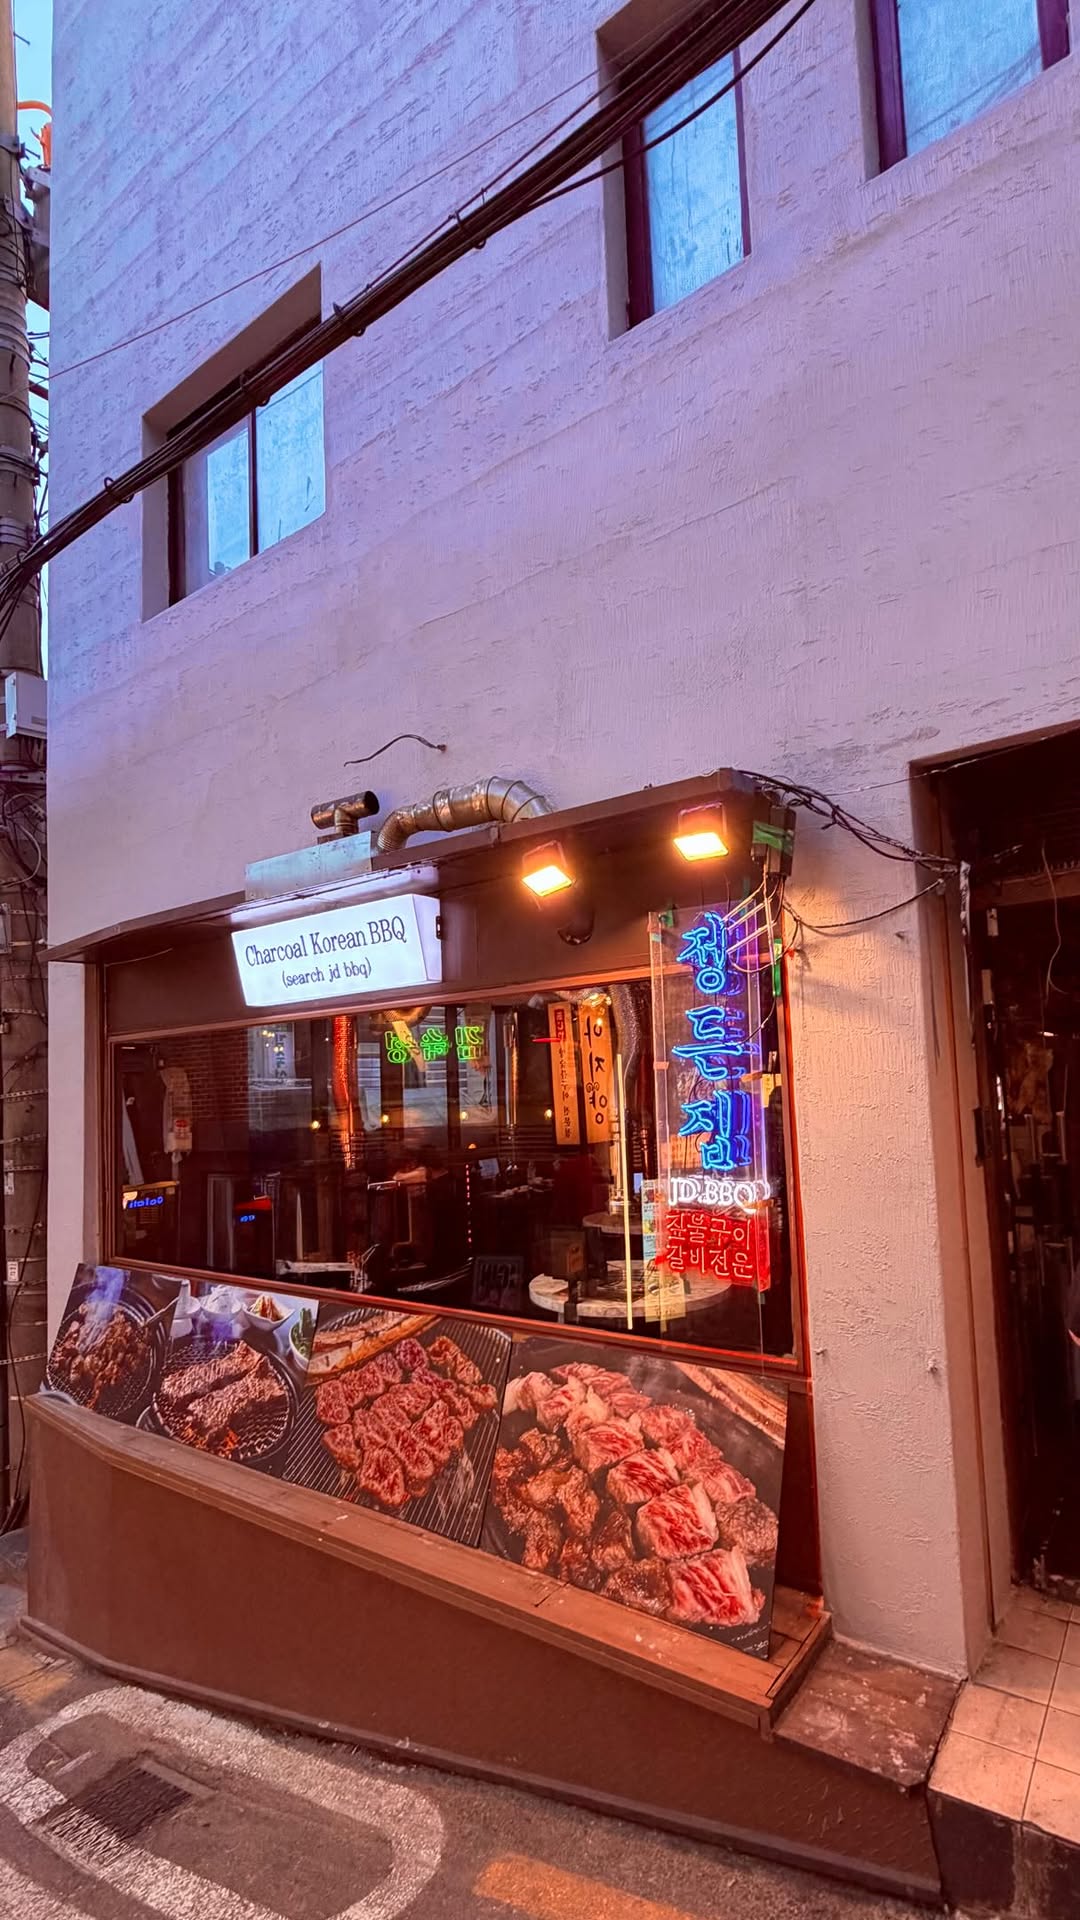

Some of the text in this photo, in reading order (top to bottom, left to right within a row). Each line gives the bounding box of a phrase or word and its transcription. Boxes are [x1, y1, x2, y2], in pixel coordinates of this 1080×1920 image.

[245, 915, 407, 967] Charcoal Korean BBQ
[281, 957, 372, 989] (search jd bbq)
[665, 1213, 751, 1250] 짚불구이
[665, 1244, 753, 1279] 갈비전문
